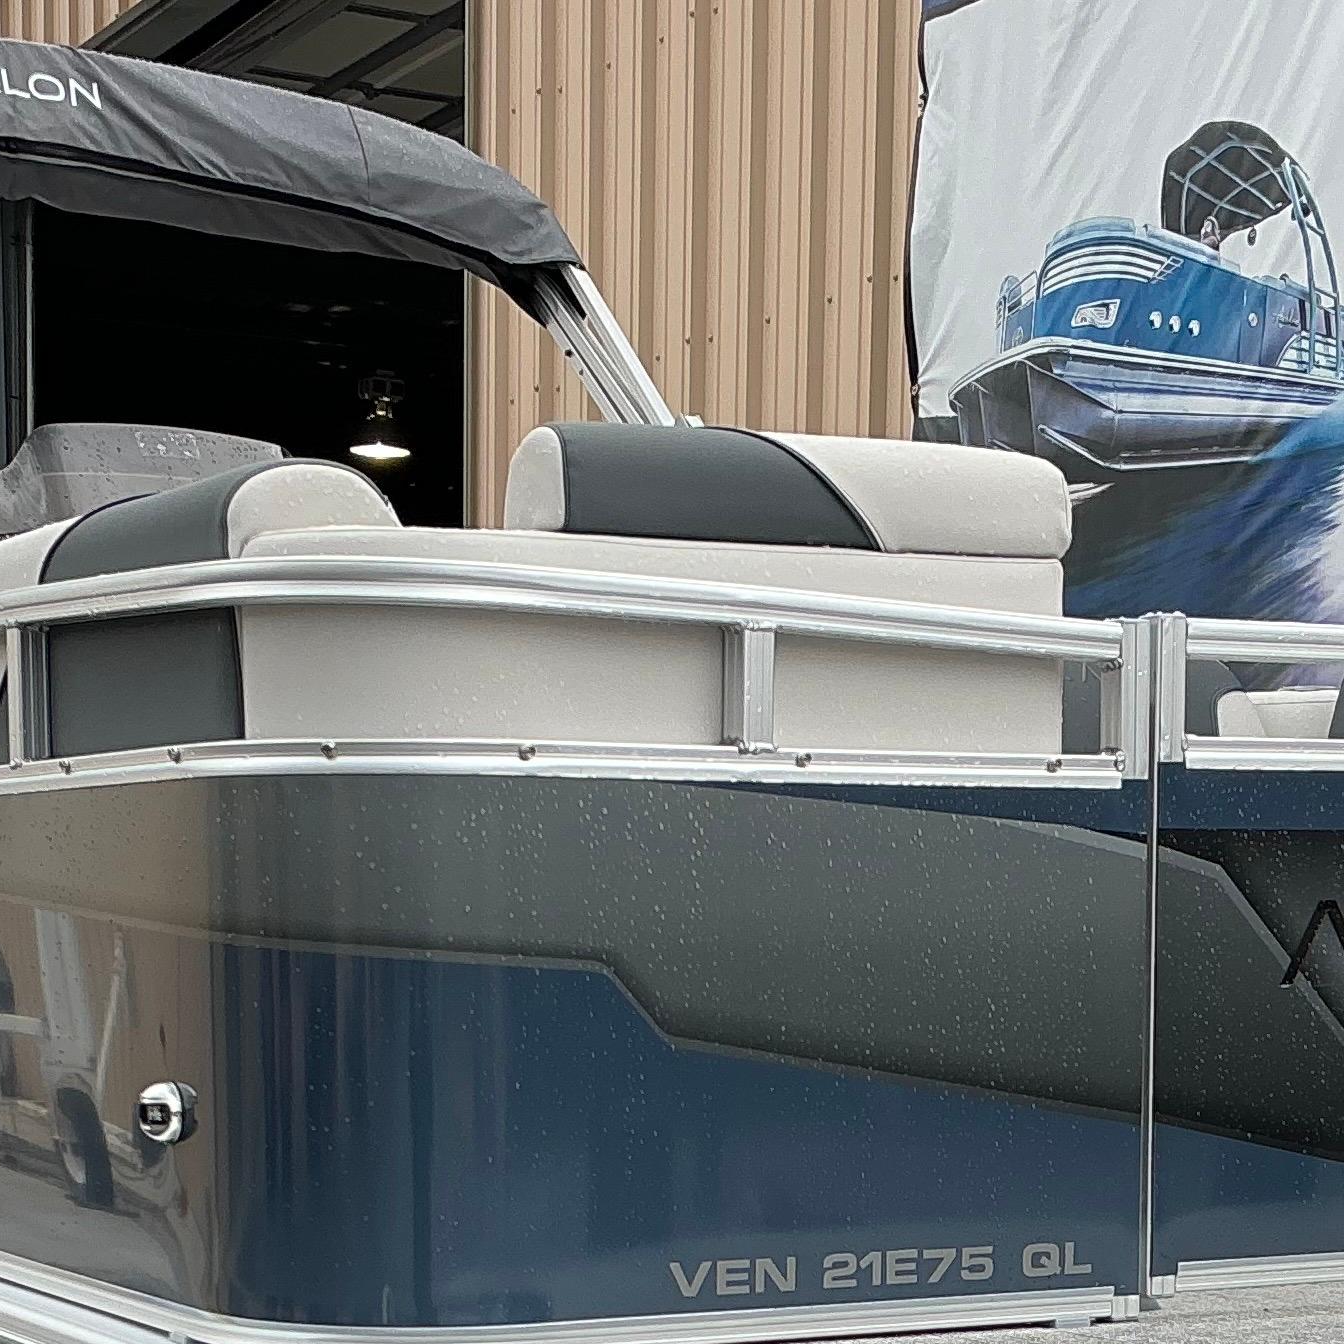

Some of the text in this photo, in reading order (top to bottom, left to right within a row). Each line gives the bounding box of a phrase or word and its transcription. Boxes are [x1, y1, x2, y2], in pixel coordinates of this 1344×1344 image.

[669, 1242, 1092, 1298] VEN 21E75 QL
